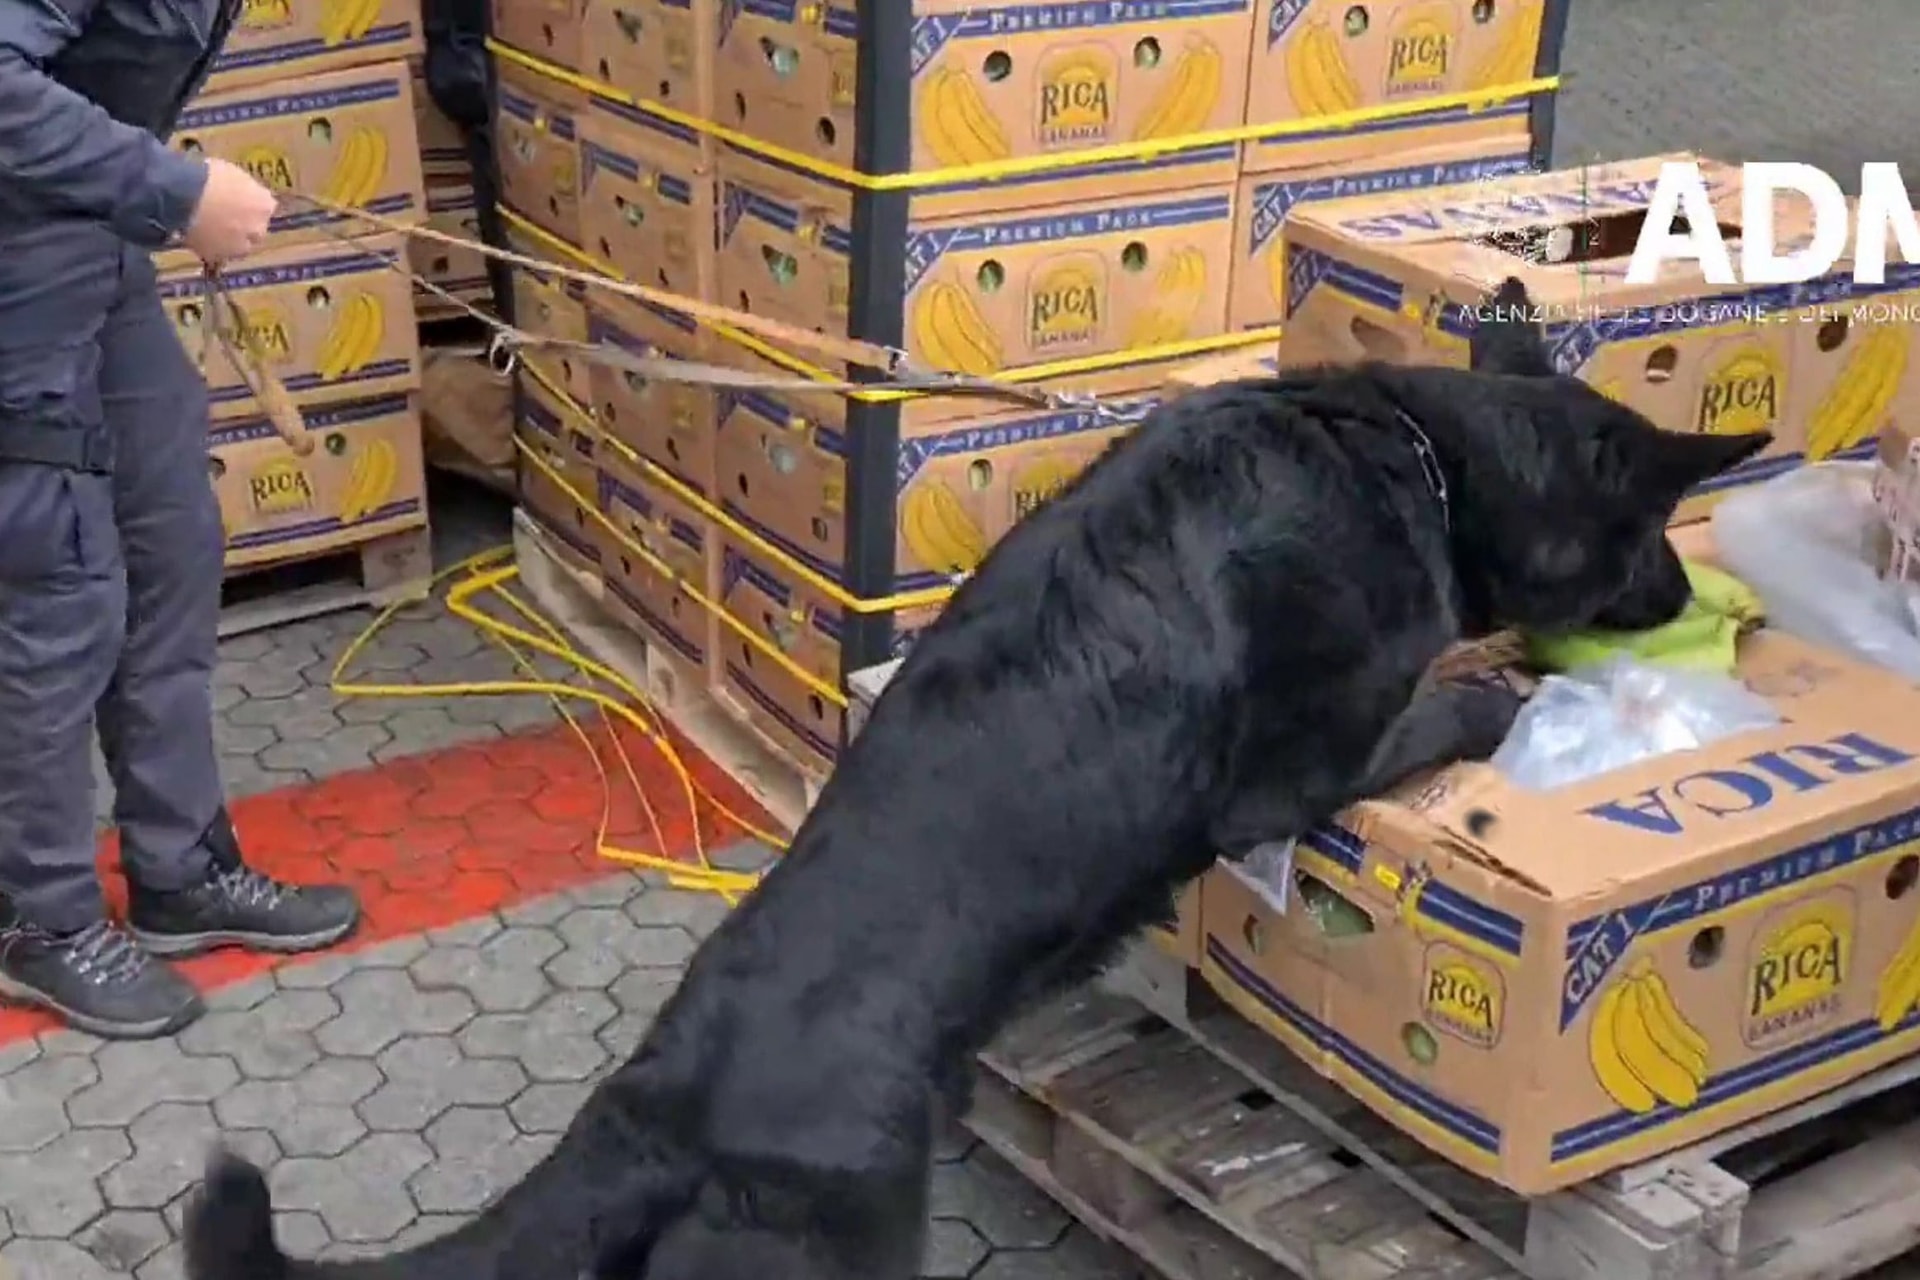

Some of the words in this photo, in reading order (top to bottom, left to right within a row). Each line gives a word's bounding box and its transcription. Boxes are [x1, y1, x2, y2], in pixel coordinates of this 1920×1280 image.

[1390, 35, 1447, 79] RICA
[1041, 80, 1109, 126] RICA
[240, 156, 292, 188] ICA
[1032, 285, 1099, 332] RICA
[1697, 374, 1776, 433] RICA
[251, 470, 314, 511] RICA
[1576, 732, 1919, 835] RICA
[1567, 932, 1614, 1004] CAT
[1751, 933, 1842, 1017] RICA
[1428, 968, 1492, 1029] RICA
